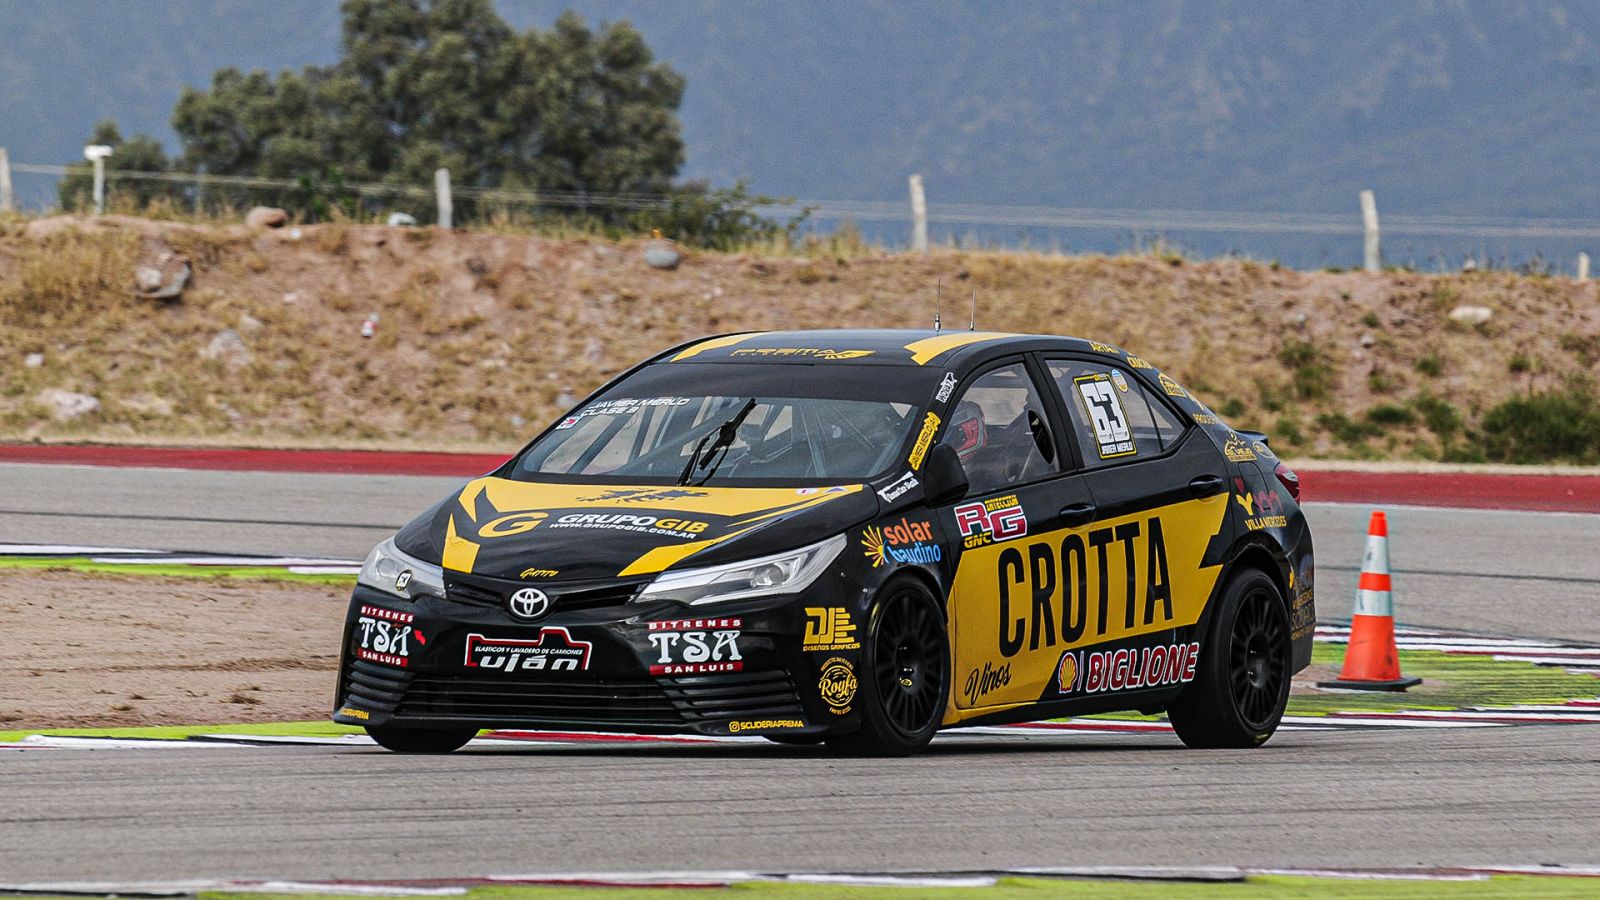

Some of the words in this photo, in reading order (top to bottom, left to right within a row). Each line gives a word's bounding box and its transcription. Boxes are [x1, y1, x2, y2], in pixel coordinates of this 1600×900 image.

[580, 407, 627, 417] CLASE
[588, 398, 639, 410] JAVIER
[637, 398, 691, 407] MERLO
[1079, 380, 1131, 444] 63
[549, 521, 698, 540] WWW.GRUPOGIB.COM.AR
[883, 517, 934, 546] solar
[953, 502, 1028, 542] RG
[963, 531, 993, 549] GNC
[886, 542, 941, 565] baudino
[997, 516, 1174, 658] CROTTA
[360, 606, 415, 623] BITRENES
[648, 619, 741, 630] BITRENES
[358, 616, 412, 657] TSA
[647, 630, 743, 664] TSA
[362, 650, 378, 662] SAN
[379, 652, 402, 666] LUIS
[549, 648, 583, 656] CAMIONES
[664, 665, 694, 674] SAN
[699, 663, 735, 672] LUIS
[1085, 641, 1200, 694] BIGLIONE
[964, 660, 1013, 706] Vinos
